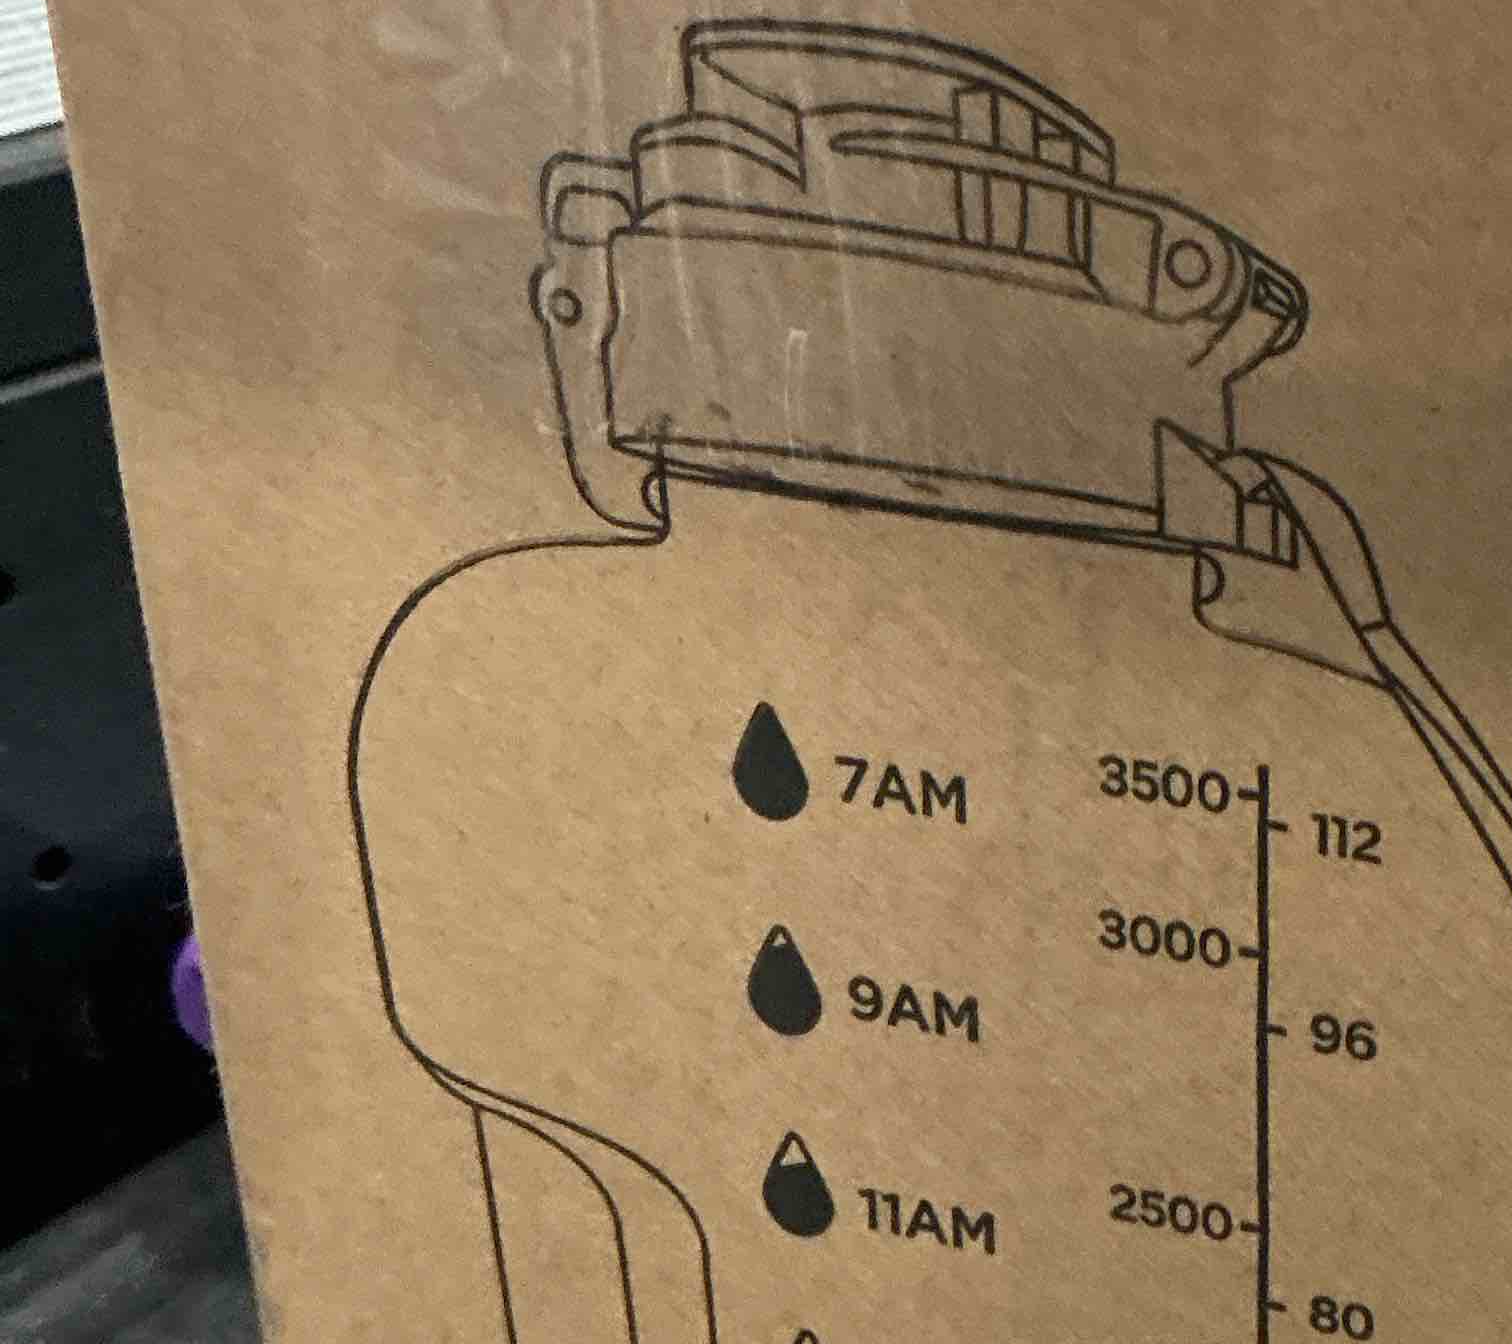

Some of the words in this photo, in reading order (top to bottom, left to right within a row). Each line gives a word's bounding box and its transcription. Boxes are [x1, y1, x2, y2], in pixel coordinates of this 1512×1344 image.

[834, 755, 967, 825] 7AM
[1098, 754, 1231, 815] 3500
[1311, 813, 1382, 865] 112
[1098, 908, 1231, 969] 3000
[848, 975, 980, 1044] 9AM
[1310, 1013, 1377, 1061] 96
[858, 1188, 996, 1257] 11AM
[1110, 1183, 1234, 1242] 2500
[1309, 1295, 1374, 1341] 80
